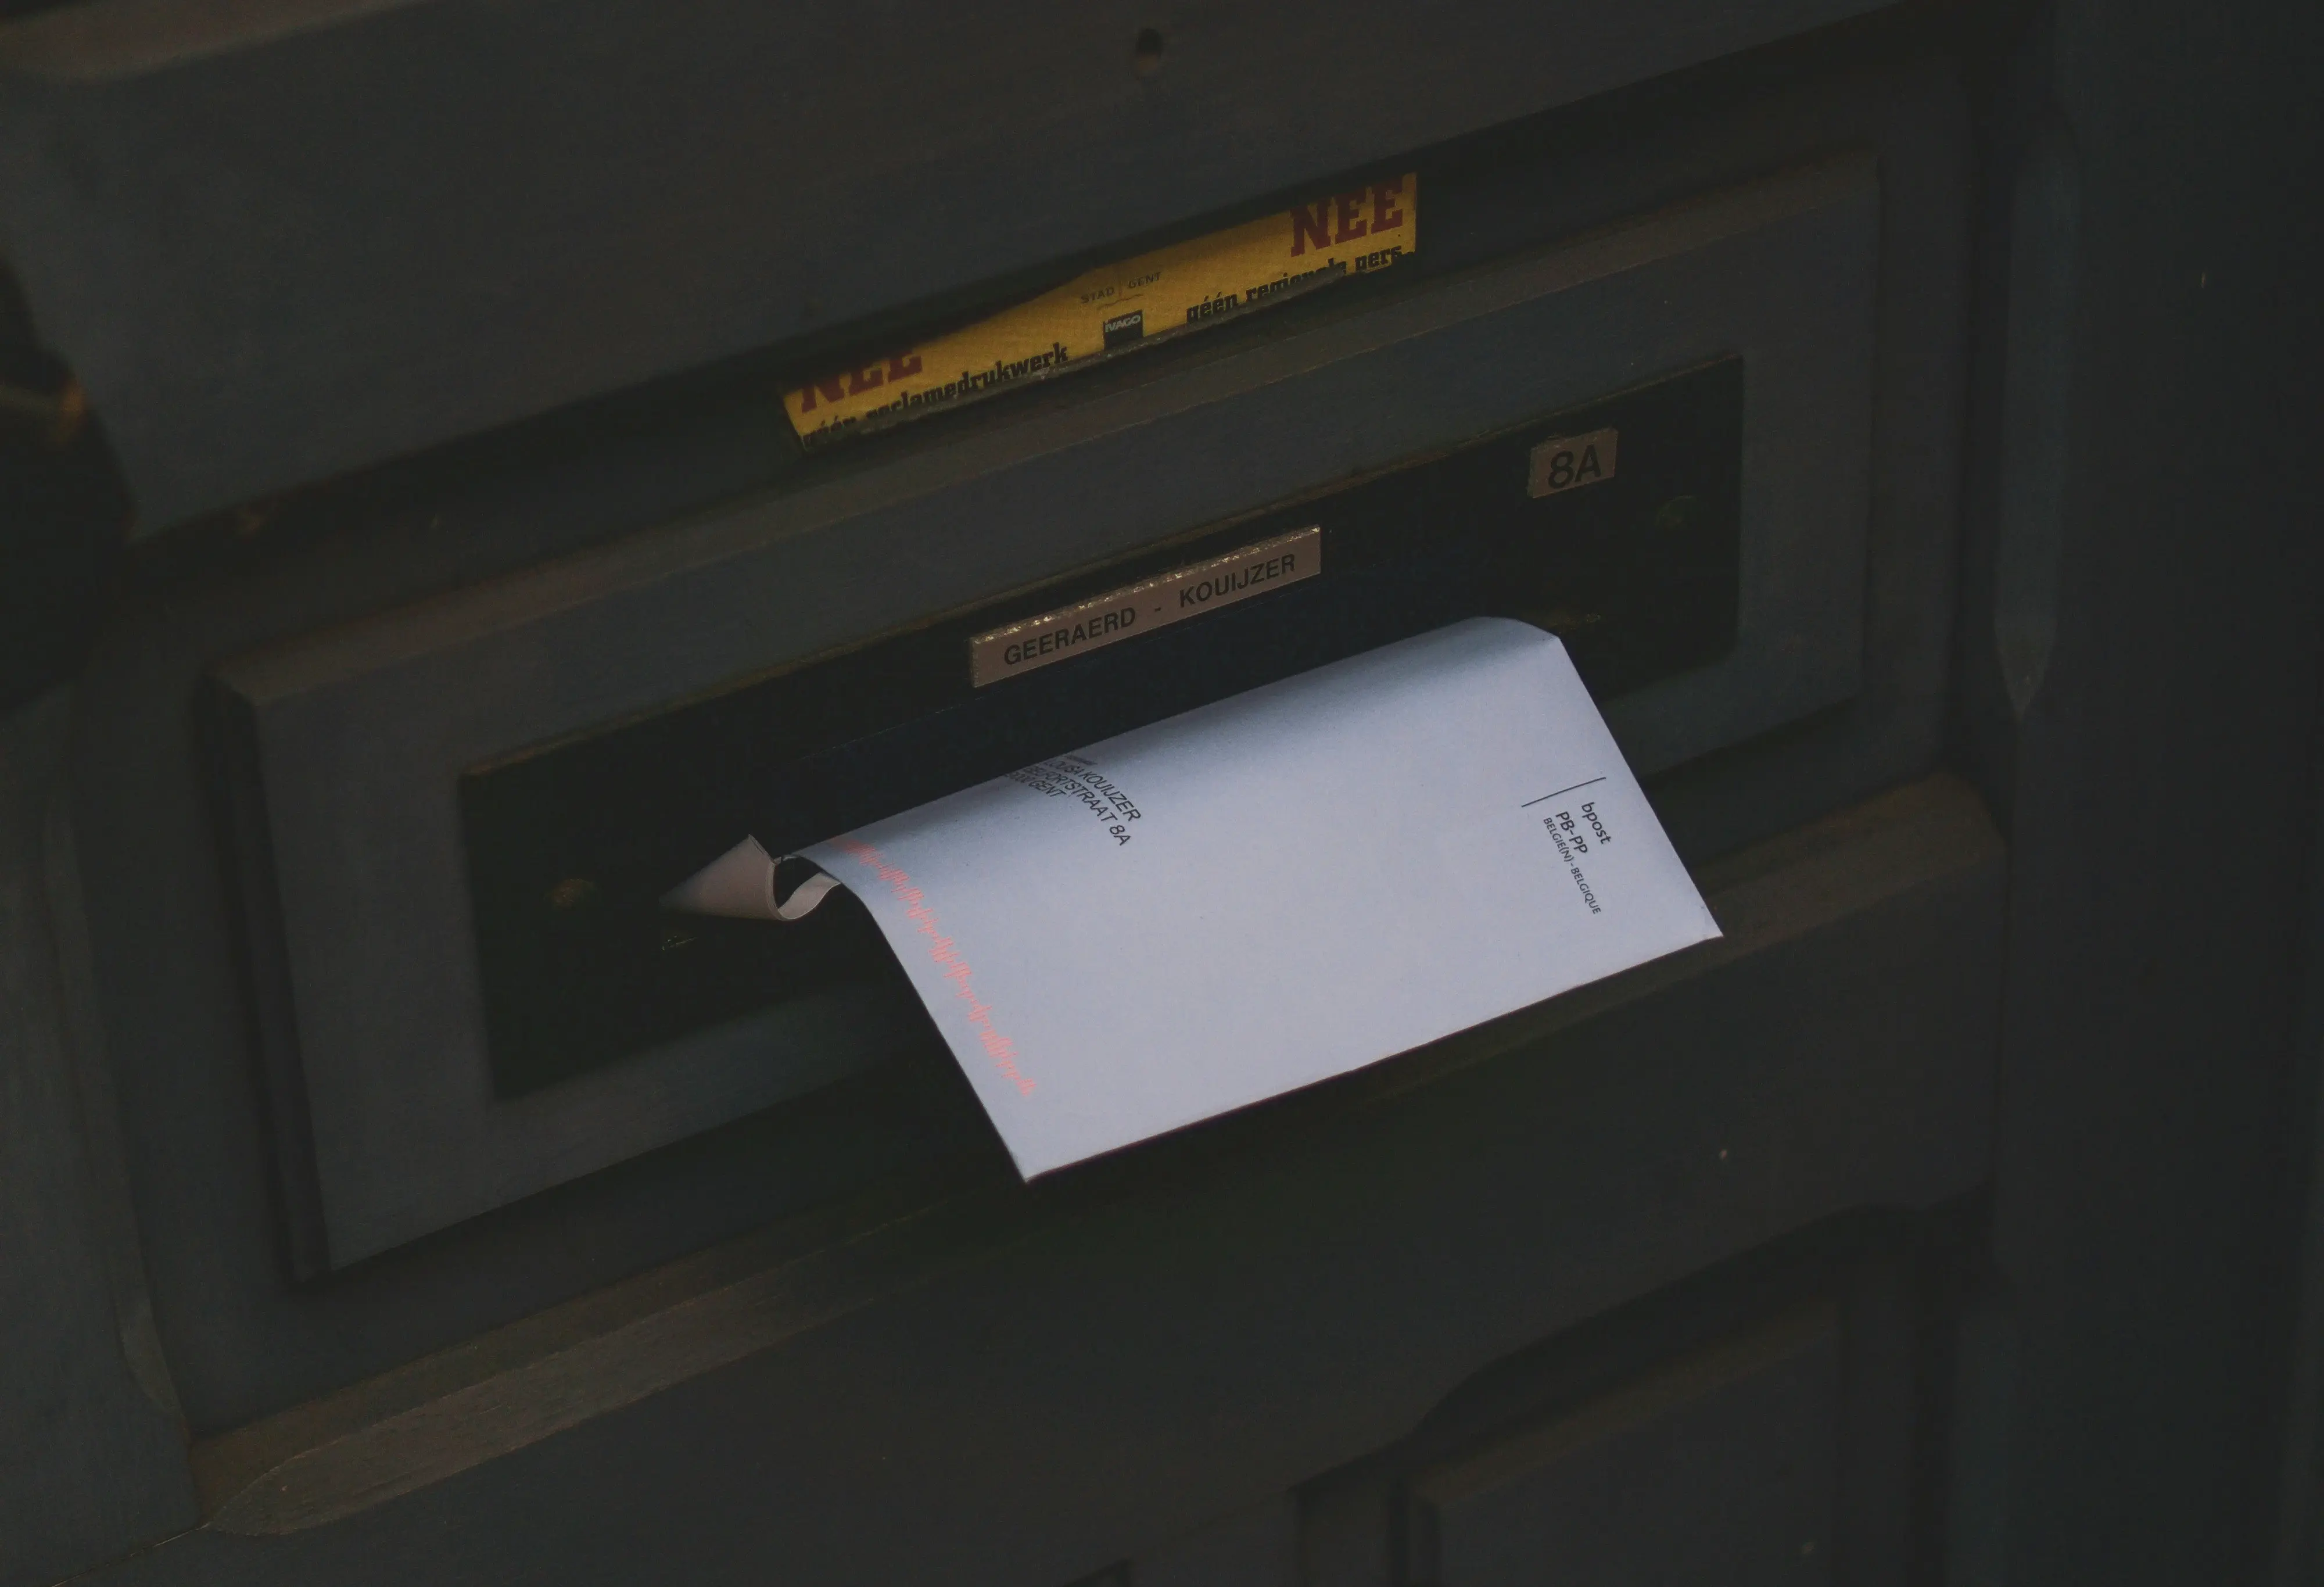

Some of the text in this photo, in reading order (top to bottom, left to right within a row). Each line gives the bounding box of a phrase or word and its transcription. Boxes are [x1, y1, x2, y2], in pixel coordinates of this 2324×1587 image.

[1290, 180, 1403, 257] NEE
[1081, 271, 1161, 303] STAD GENT
[1548, 444, 1601, 489] 8A
[1004, 607, 1136, 665] GEERAERD
[1179, 553, 1295, 608] KOUIJZER
[1028, 780, 1067, 797] GENT
[1079, 771, 1141, 821] KOUIJZER
[1109, 825, 1131, 846] 8A
[1581, 801, 1611, 844] bpost
